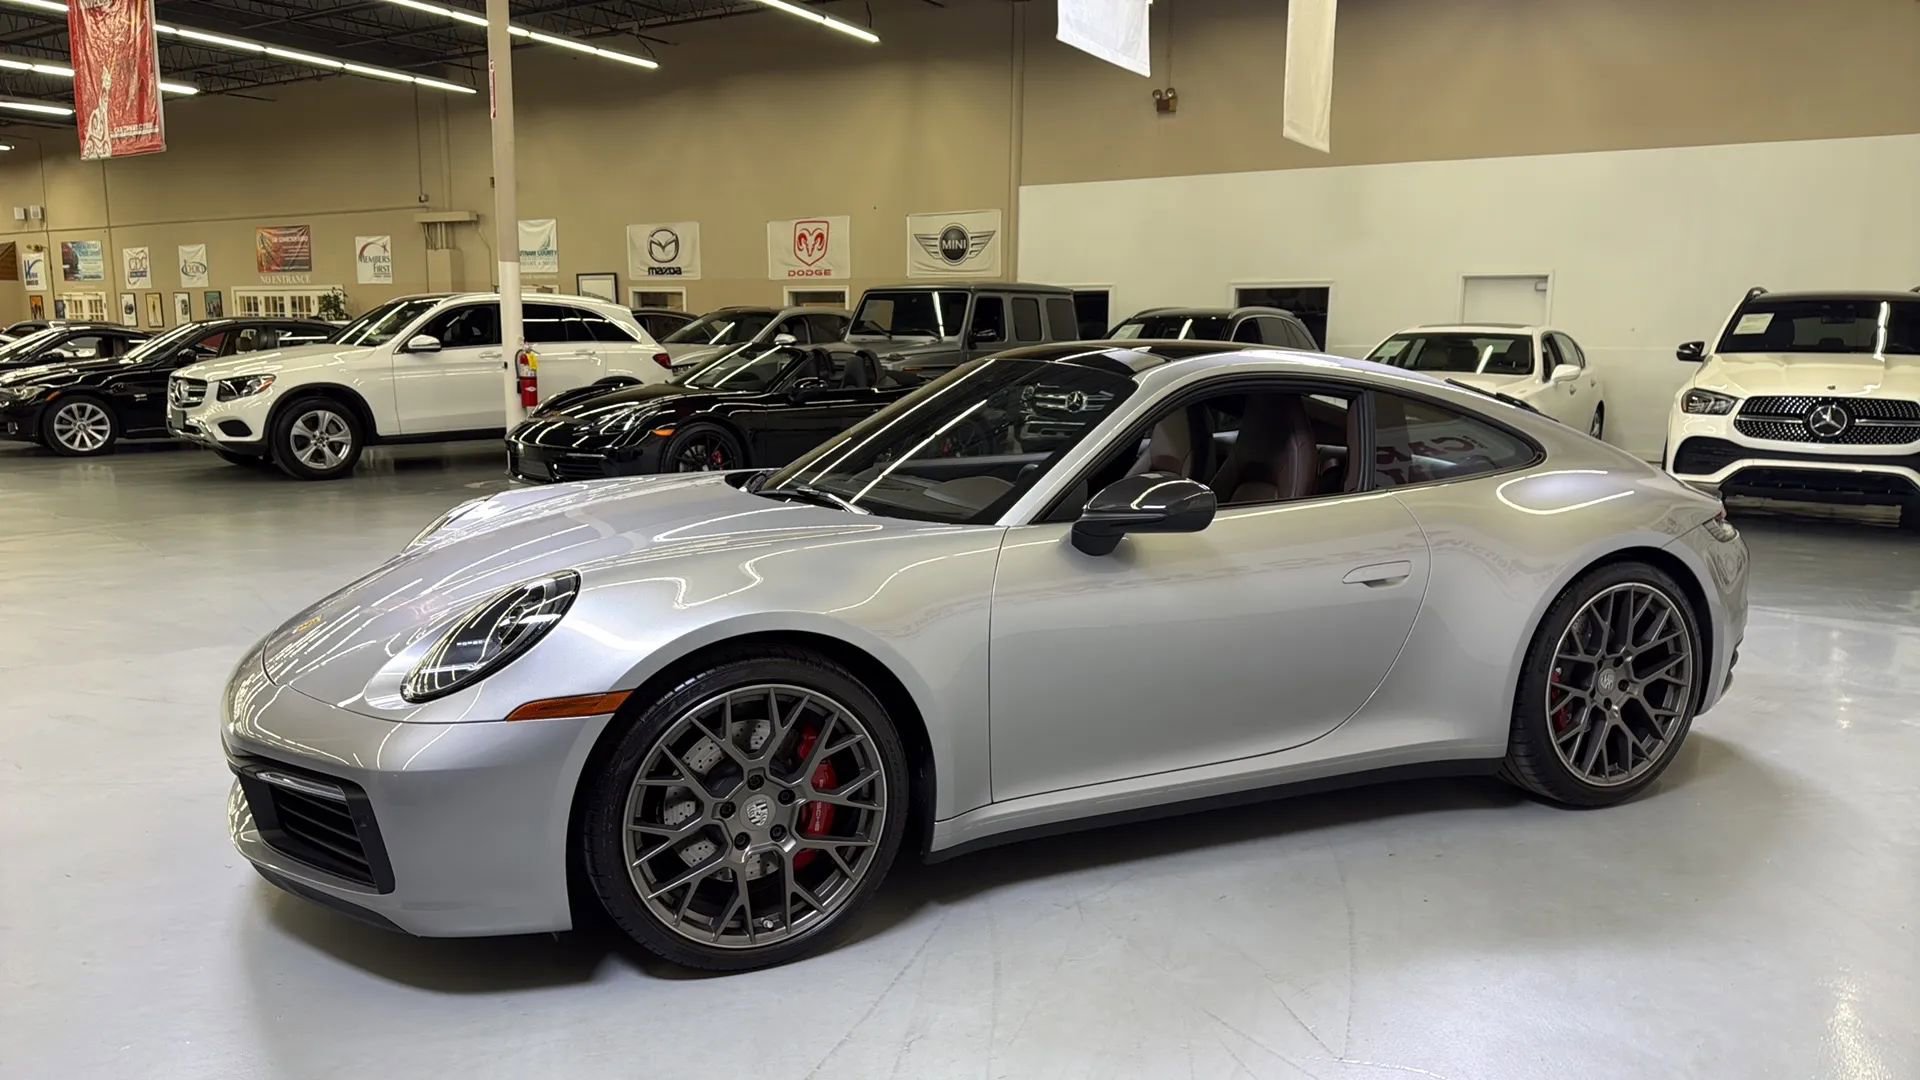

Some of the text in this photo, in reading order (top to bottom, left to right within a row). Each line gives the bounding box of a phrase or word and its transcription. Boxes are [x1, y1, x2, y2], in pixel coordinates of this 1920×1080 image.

[942, 239, 967, 250] MINI
[373, 263, 390, 273] FIRST
[788, 268, 832, 277] DODGE
